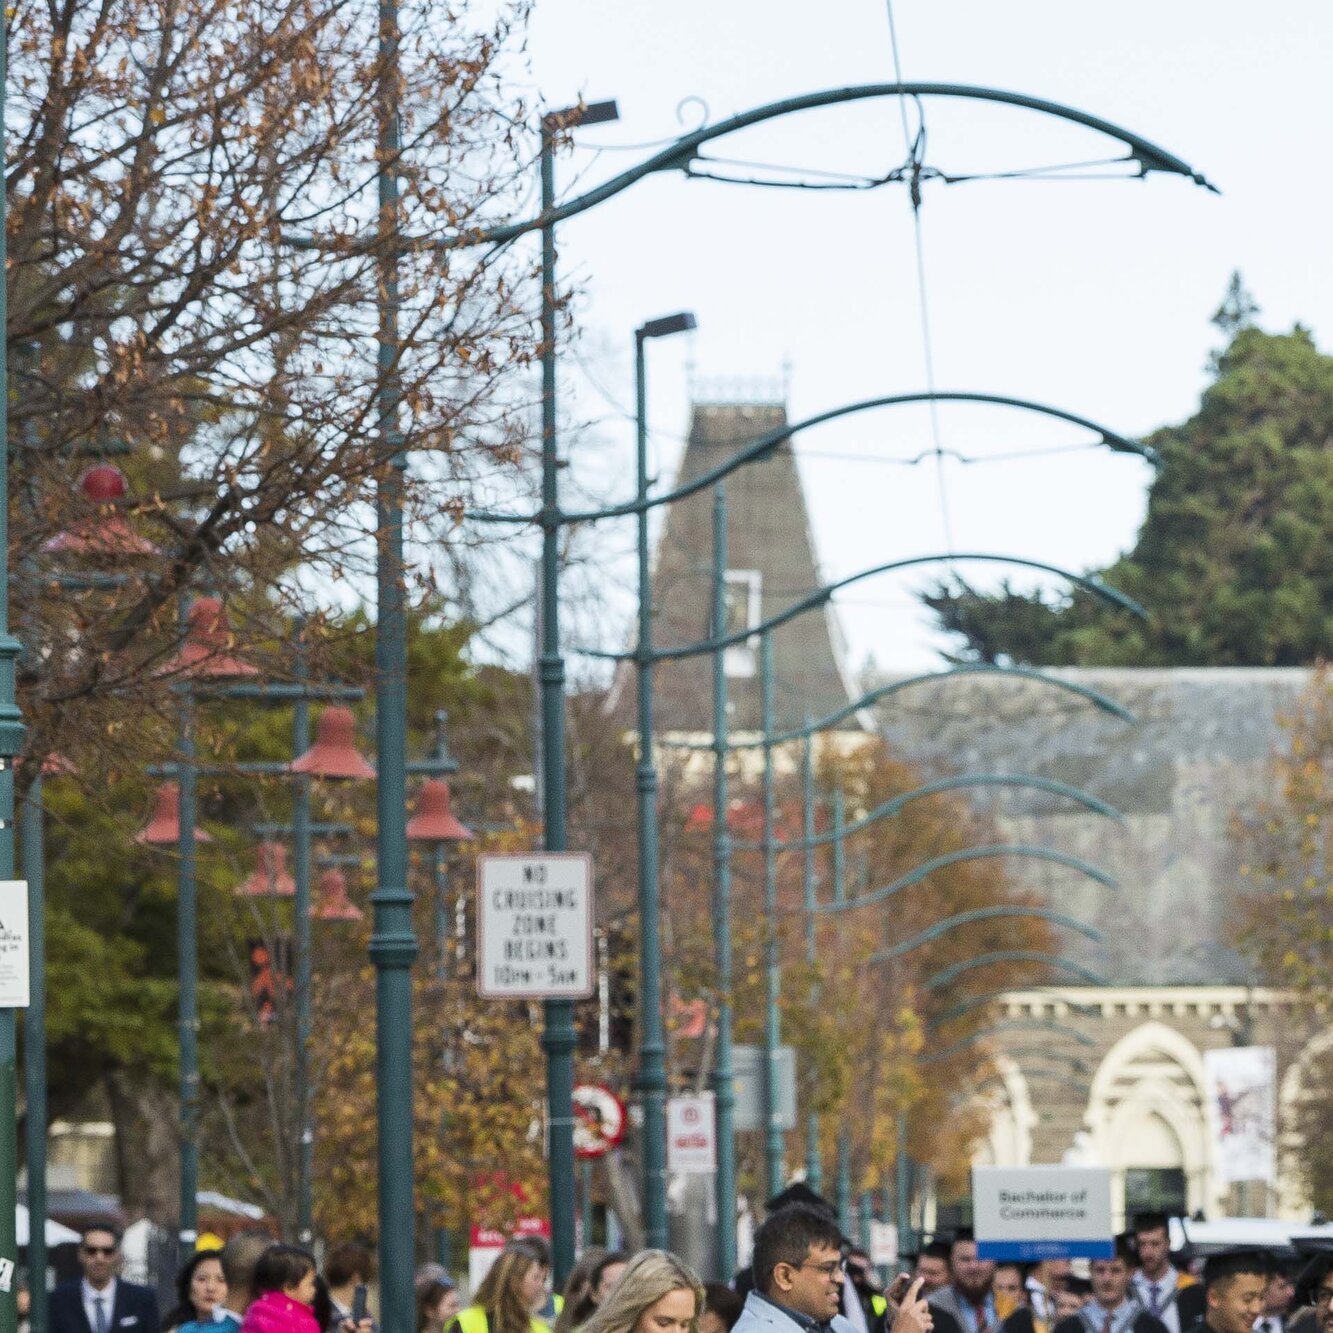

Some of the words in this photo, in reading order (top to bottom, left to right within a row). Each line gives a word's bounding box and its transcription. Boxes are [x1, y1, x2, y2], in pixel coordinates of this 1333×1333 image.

[522, 864, 547, 882] NO
[492, 887, 577, 911] CRUISING
[513, 914, 557, 935] ZONE
[503, 940, 568, 960] BEGINS
[1000, 1190, 1067, 1202] Bachelor
[1071, 1189, 1087, 1202] of
[1000, 1206, 1086, 1219] Commerce
